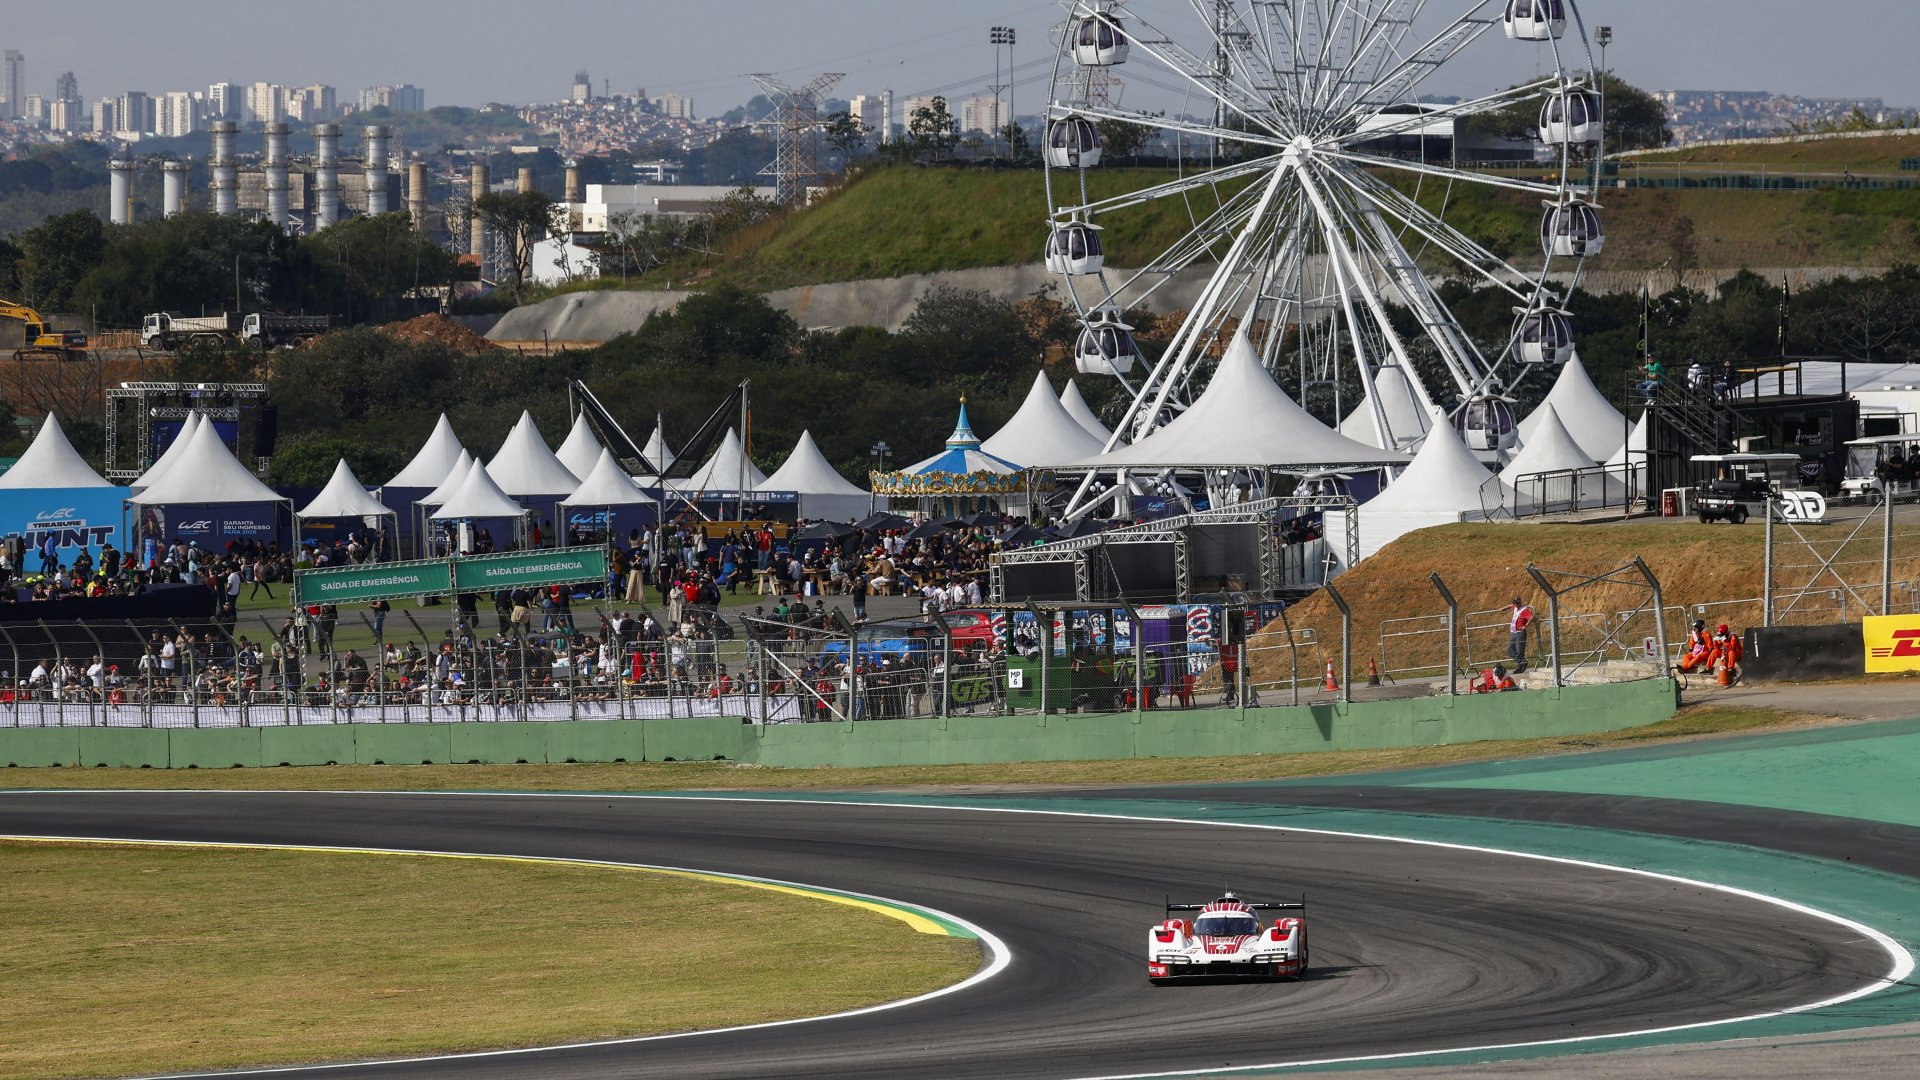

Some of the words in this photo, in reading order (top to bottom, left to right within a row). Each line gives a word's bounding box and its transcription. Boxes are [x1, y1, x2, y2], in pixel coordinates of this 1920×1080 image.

[36, 507, 76, 520] WEC
[32, 520, 82, 529] TREASURE
[178, 520, 212, 530] WEC
[8, 525, 115, 551] HUNT
[485, 567, 512, 576] SAÍDA
[512, 566, 525, 574] DE
[525, 561, 583, 573] EMERGÊNCIA
[320, 580, 348, 591] SAÍDA
[348, 580, 361, 588] DE
[361, 575, 419, 587] EMERGÊNCIA
